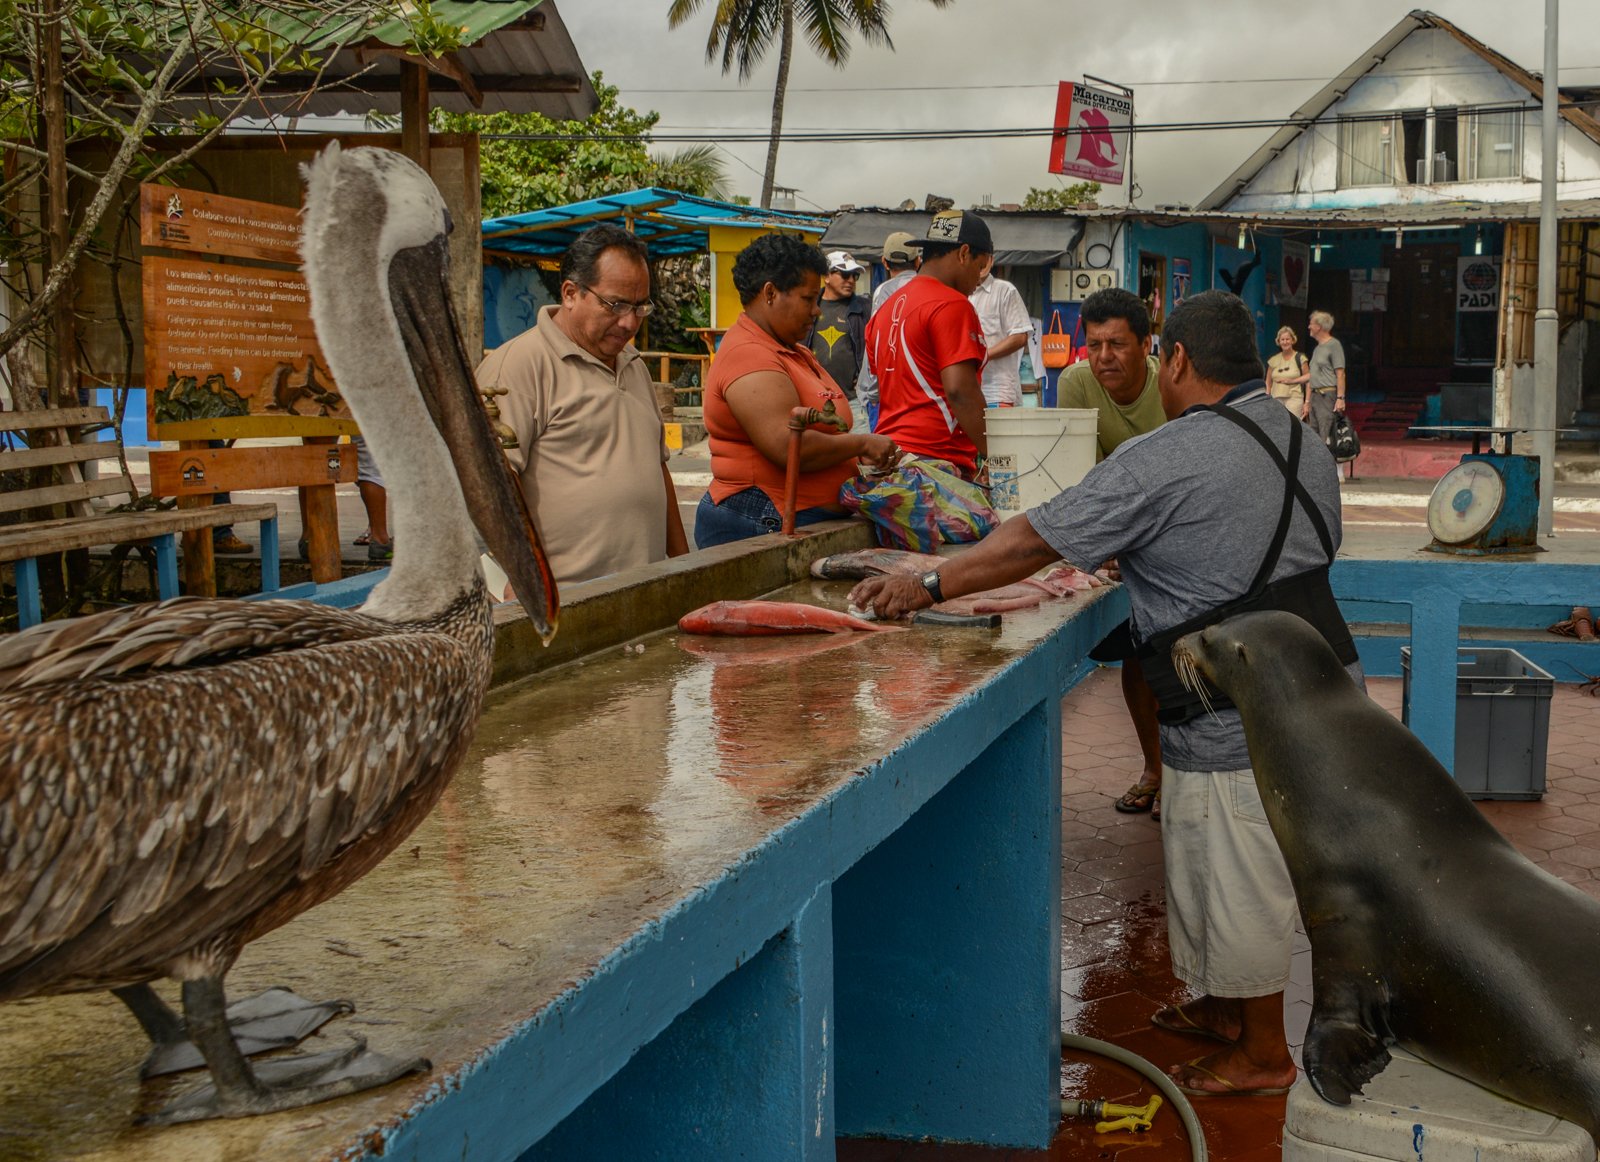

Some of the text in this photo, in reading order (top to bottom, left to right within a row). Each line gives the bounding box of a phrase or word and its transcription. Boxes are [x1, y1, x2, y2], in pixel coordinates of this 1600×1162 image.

[1073, 86, 1130, 110] Macarron
[1073, 97, 1130, 116] SCUBA DIVE CENTER
[193, 208, 224, 222] Colabore
[225, 216, 237, 225] con
[238, 216, 245, 225] la
[288, 223, 296, 232] de
[166, 268, 179, 279] Los
[181, 270, 210, 282] animales
[259, 278, 278, 288] tienen
[167, 297, 189, 307] puede
[1460, 293, 1496, 307] PADI
